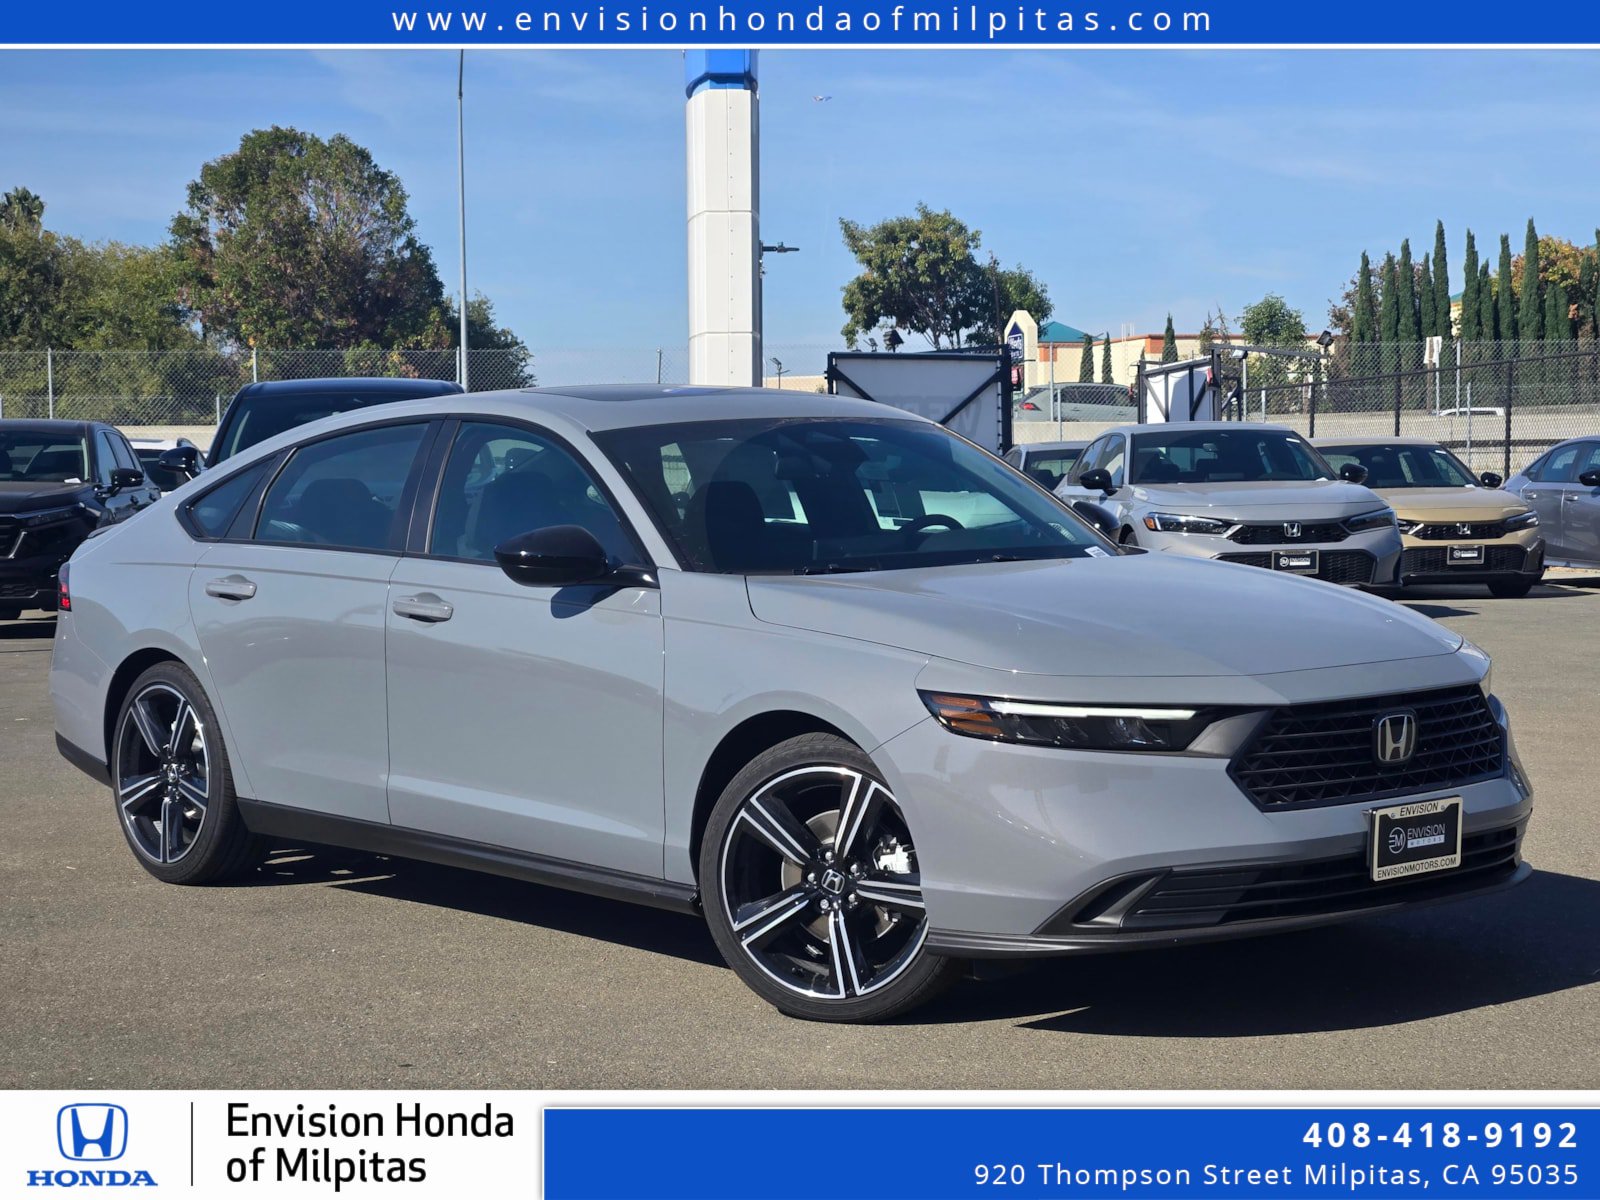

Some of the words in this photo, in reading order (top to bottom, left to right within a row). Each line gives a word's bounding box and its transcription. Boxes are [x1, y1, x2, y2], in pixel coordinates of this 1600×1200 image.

[1400, 802, 1439, 817] ENVISION
[1407, 823, 1445, 840] ENVISION
[1377, 857, 1457, 879] ENVISIONMOTORS.COM
